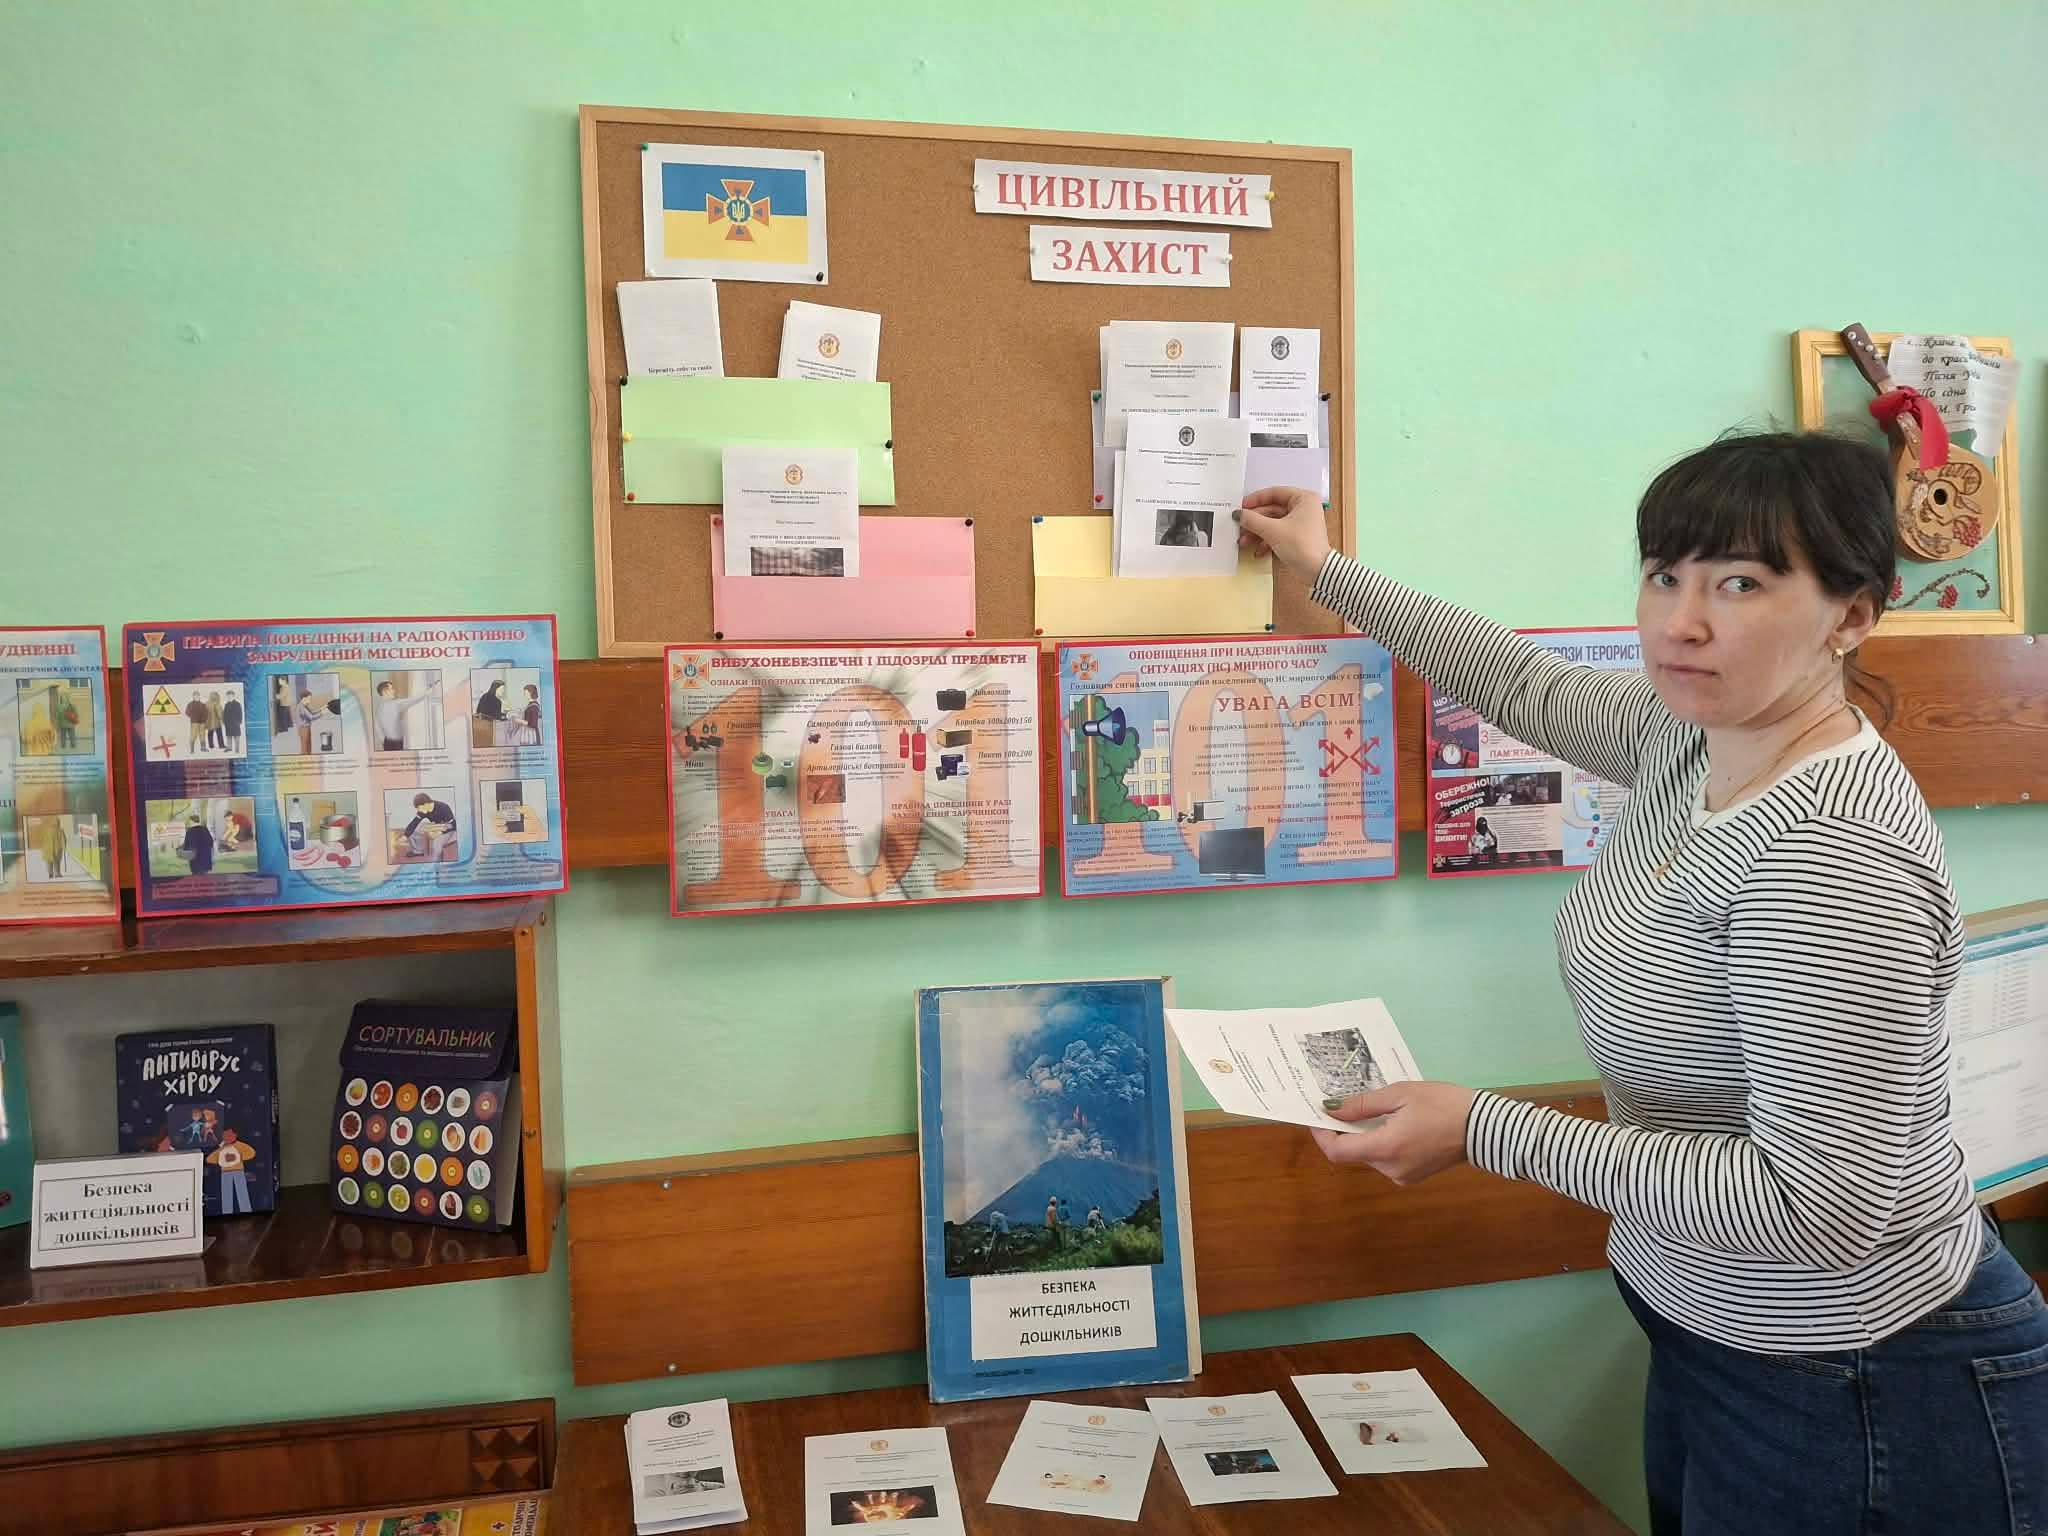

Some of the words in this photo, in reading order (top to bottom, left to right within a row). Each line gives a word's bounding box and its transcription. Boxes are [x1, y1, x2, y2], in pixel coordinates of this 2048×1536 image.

[997, 173, 1249, 217] ЦИВІЛЬНИЙ
[1051, 239, 1209, 275] ЗАХИСТ
[184, 636, 261, 649] ПРАВИЛА
[267, 633, 364, 646] ПОВЕДІНКИ
[370, 632, 393, 643] НА
[398, 629, 525, 643] РАДІОАКТИВНО
[247, 645, 361, 663] ЗАБРУДНЕНІЙ
[367, 645, 472, 660] МІСЦЕВОСТІ
[711, 656, 863, 668] ВИБУХОНЕБЕЗПЕЧНІ
[876, 655, 948, 666] ПІДОЗРІЛІ
[951, 653, 1028, 665] ПРЕДМЕТИ
[1129, 648, 1207, 661] ОПОВІЩЕННЯ
[1210, 647, 1233, 658] ПРИ
[1235, 643, 1328, 657] НАДЗВИЧАЙНИХ
[1140, 663, 1205, 675] СИТУАЦІЯХ
[1233, 659, 1289, 672] МИРНОГО
[1291, 657, 1320, 669] ЧАСУ
[710, 678, 748, 686] ОЗНАКИ
[1216, 695, 1289, 713] УВАГА
[1300, 692, 1361, 709] ВСІМ!
[1435, 777, 1489, 801] ОБЕРЕЖНО!
[765, 808, 796, 818] УВАГА!
[360, 1024, 495, 1048] СОРТУВАЛЬНИК
[84, 1182, 152, 1198] Безпека
[44, 1197, 190, 1223] життєдіяльності
[54, 1221, 180, 1244] дошкільників
[1041, 1280, 1097, 1295] БЕЗПЕКА
[1008, 1299, 1130, 1320] ЖИТТЄДІЯЛЬНОСТІ
[1020, 1325, 1122, 1346] ДОШКІЛЬНИКІВ
